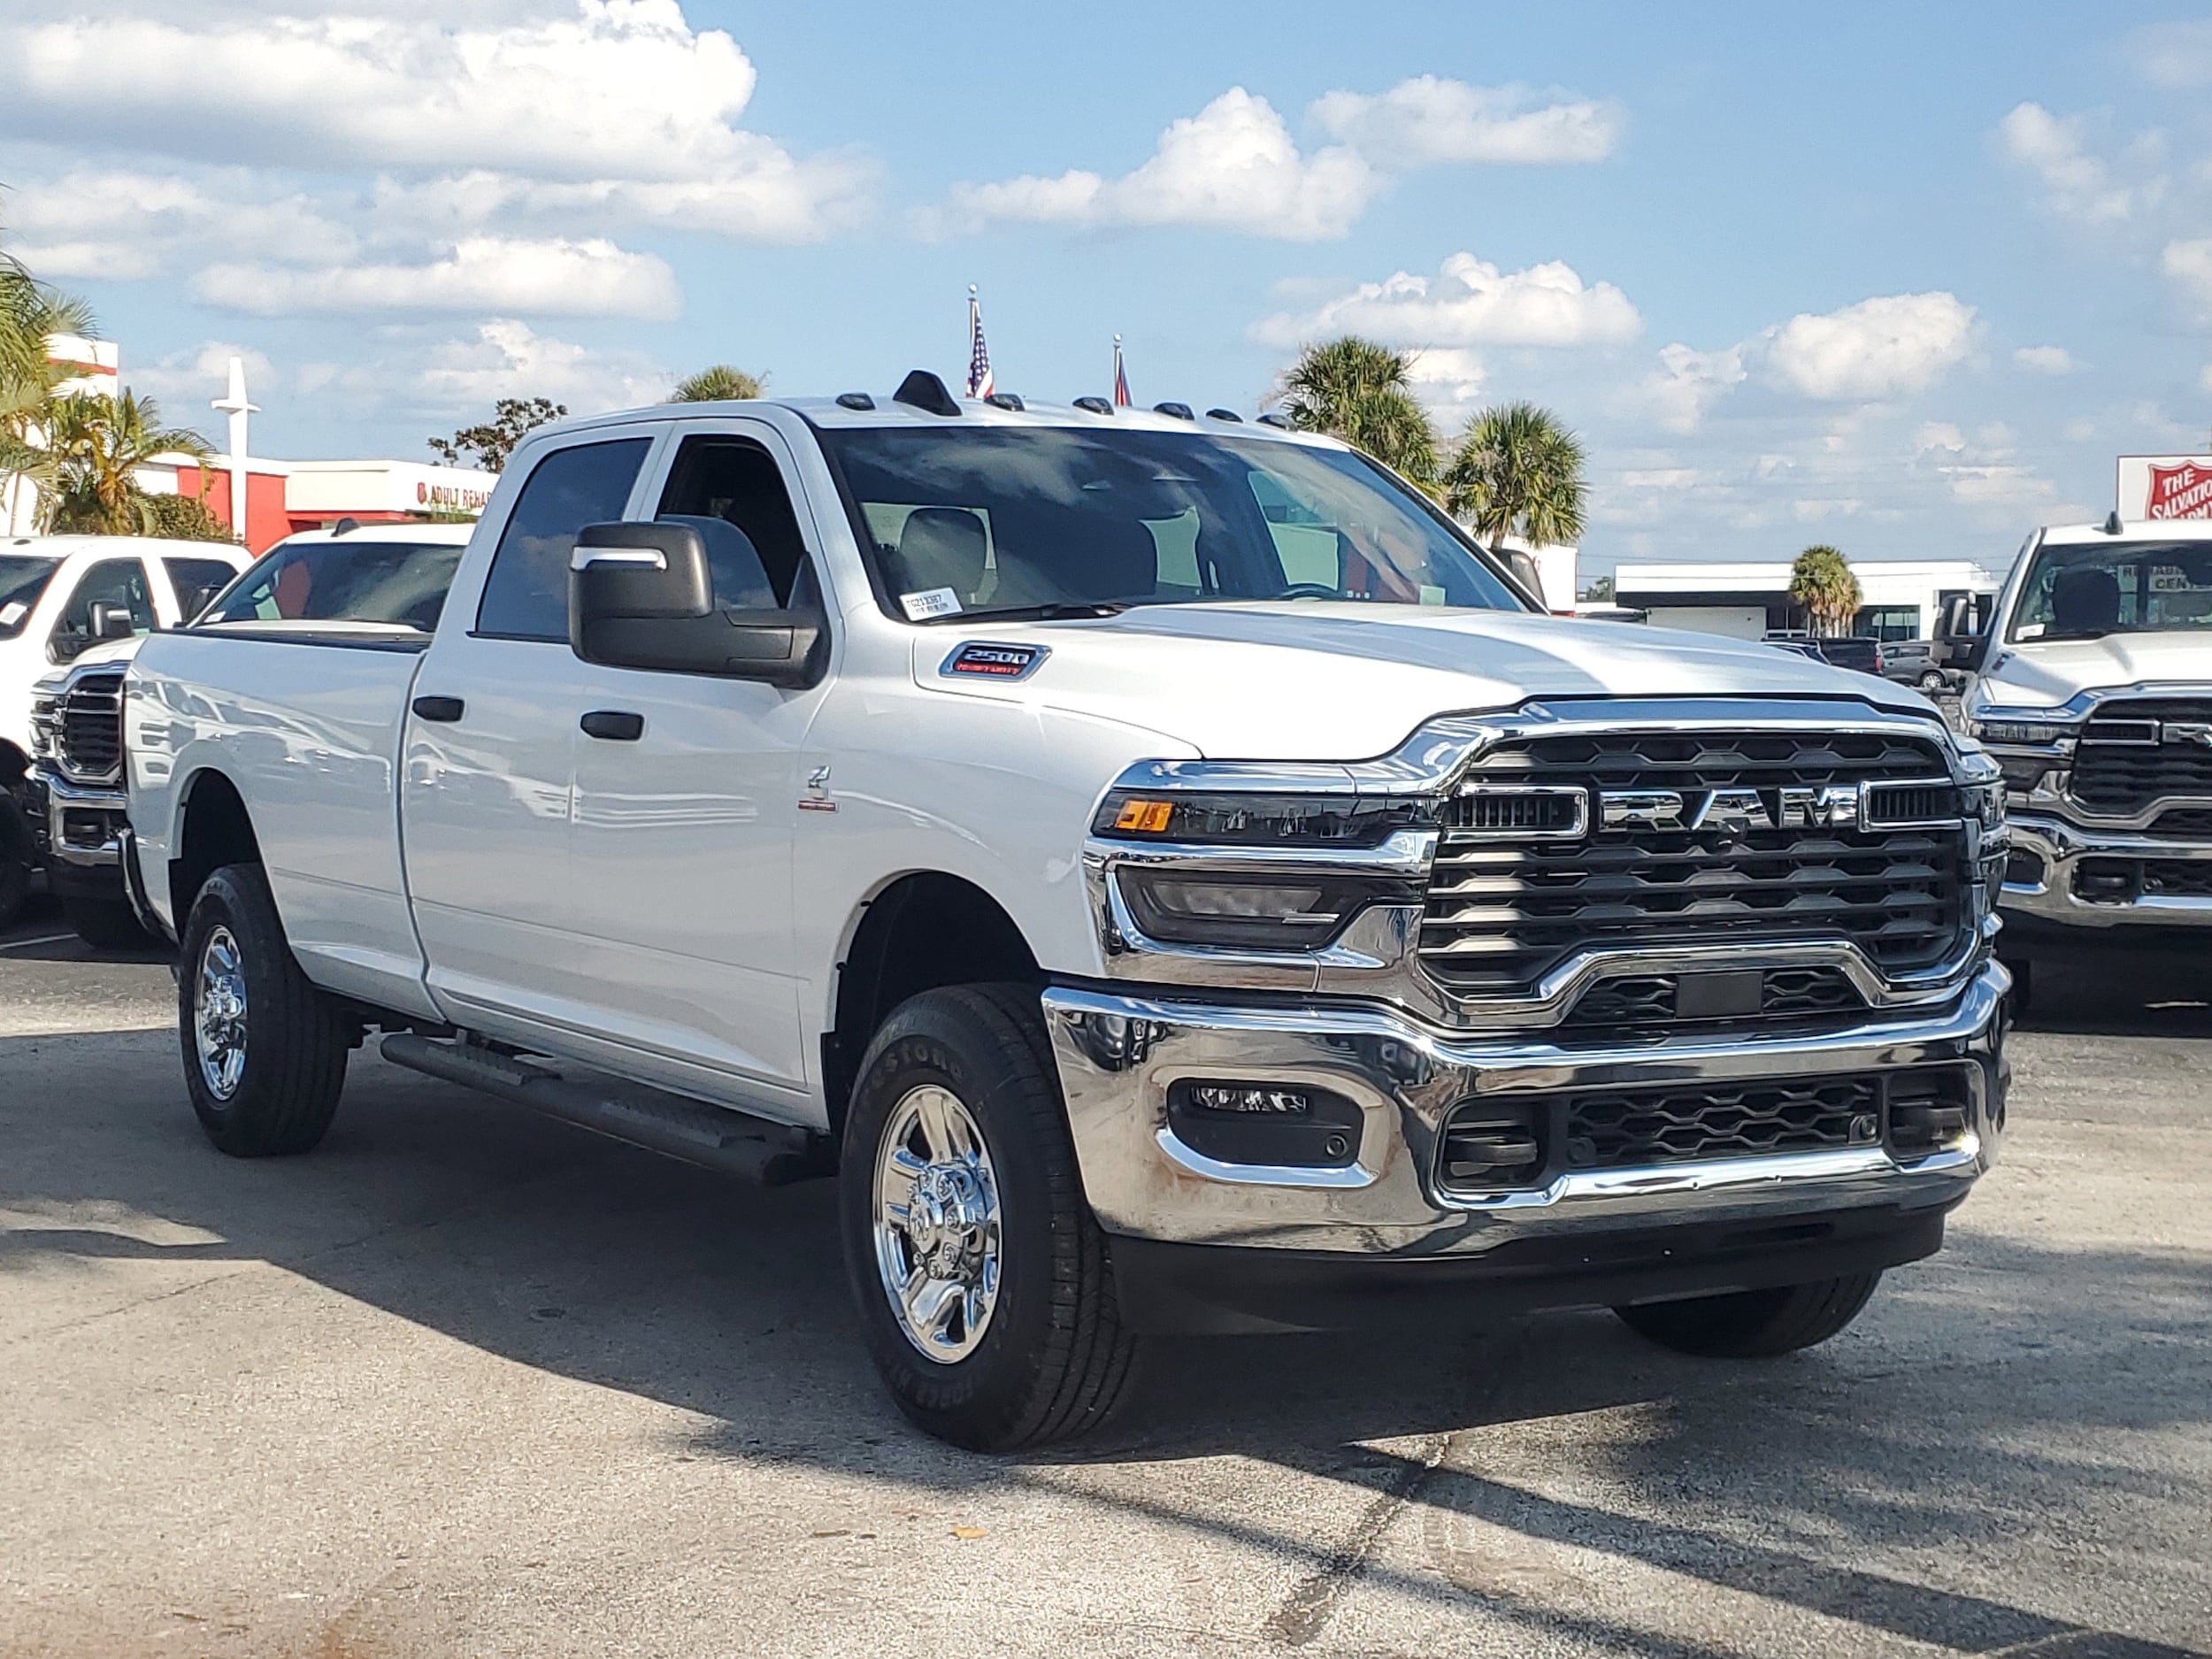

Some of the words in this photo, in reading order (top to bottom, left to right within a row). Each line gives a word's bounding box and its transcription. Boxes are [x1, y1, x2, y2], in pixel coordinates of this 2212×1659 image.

[431, 485, 459, 505] ADULT
[2162, 467, 2196, 497] THE
[2151, 479, 2212, 520] SALVATIO
[963, 649, 1030, 664] 2500
[1597, 787, 1858, 833] RAM
